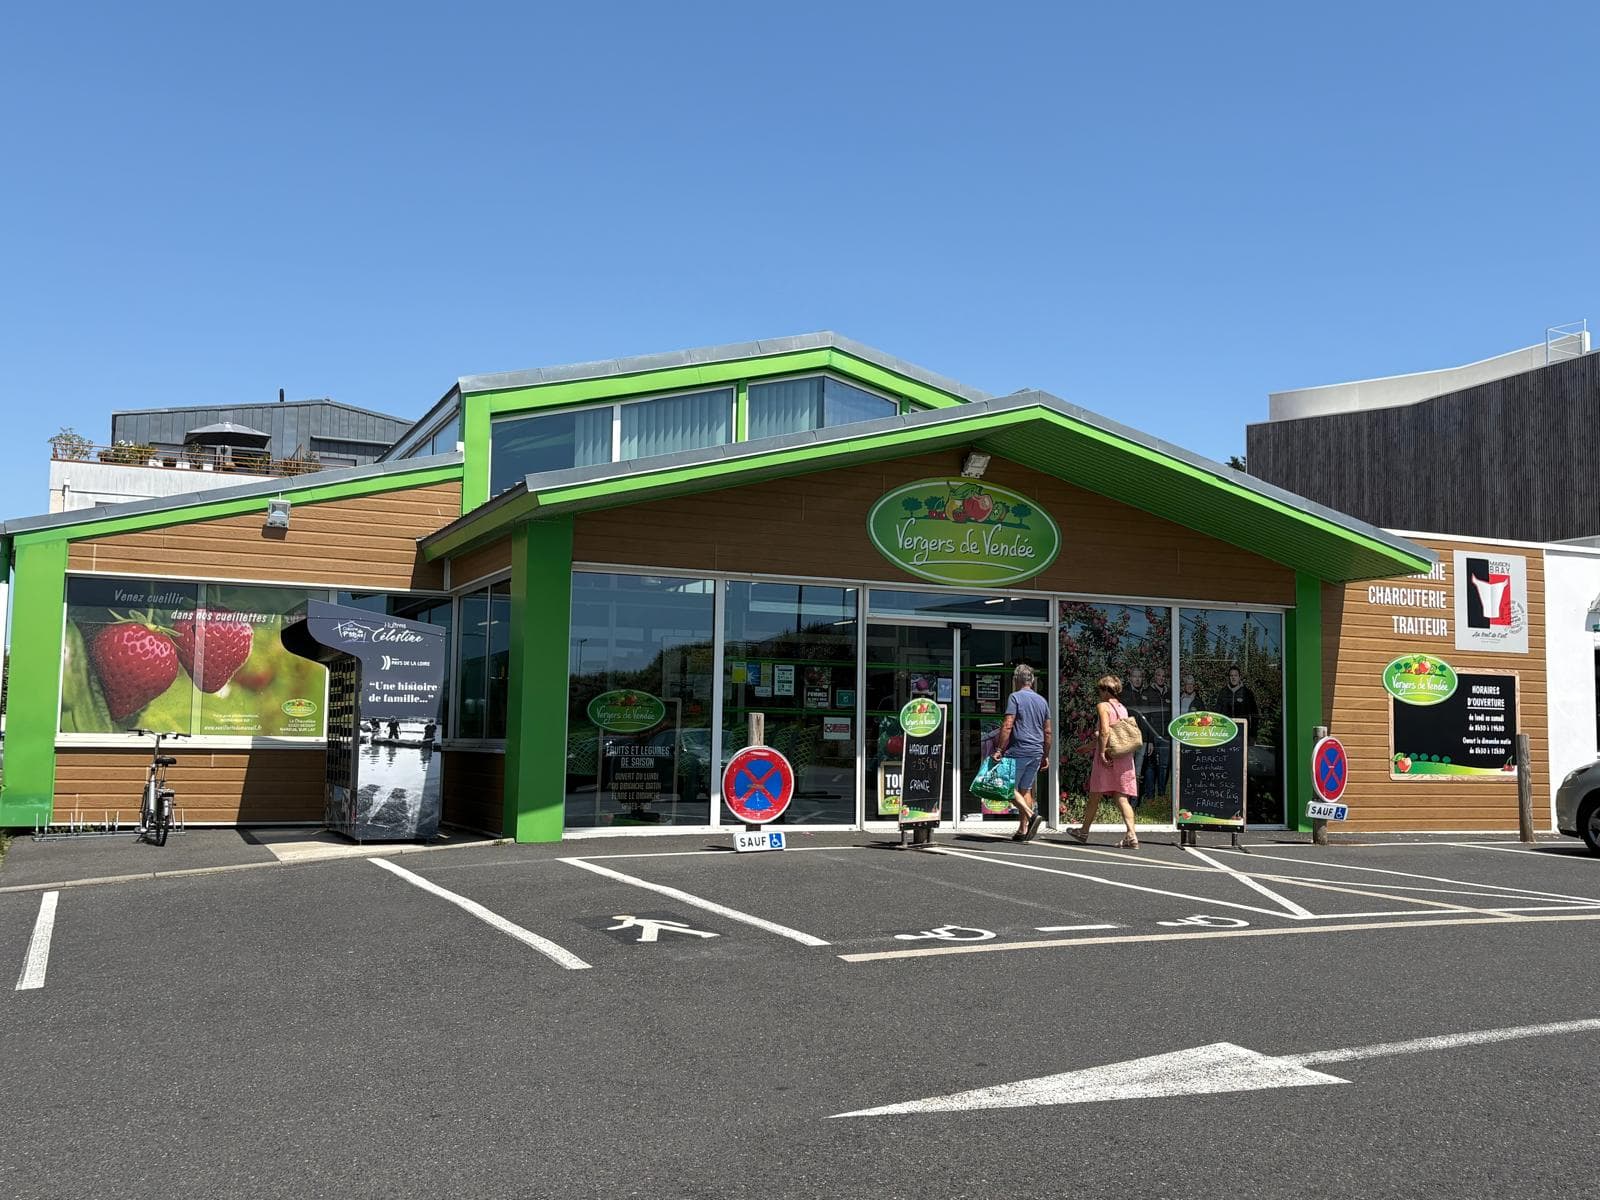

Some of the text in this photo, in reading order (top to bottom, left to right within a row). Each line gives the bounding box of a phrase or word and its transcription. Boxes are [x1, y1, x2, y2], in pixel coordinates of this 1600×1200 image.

[895, 518, 1036, 566] Vergers de Vendée
[1489, 560, 1511, 568] MAISON
[1489, 566, 1511, 574] BRAY
[114, 589, 184, 605] Venez cueillir
[1367, 585, 1447, 609] CHARCUTERIE
[170, 609, 193, 621] dans
[196, 611, 212, 621] nos
[215, 611, 267, 623] cueillettes
[1391, 615, 1448, 637] TRAITEUR
[397, 682, 438, 691] histoire
[1391, 672, 1449, 695] Vergers de Vendée
[1471, 685, 1500, 695] HORAIRES
[368, 693, 382, 702] de
[1467, 697, 1505, 708] D'OUVERTURE
[596, 705, 656, 725] Vergers de Vendée
[1474, 712, 1485, 721] lundi
[1491, 713, 1505, 722] samedi
[905, 712, 919, 731] Vergers
[924, 712, 936, 725] Vendée
[1176, 725, 1229, 741] Vergers de Vendée
[1462, 737, 1476, 745] Ouvert
[1477, 737, 1481, 745] le
[1481, 737, 1500, 745] dimanche
[606, 746, 630, 755] FRUITS
[631, 746, 640, 755] ET
[909, 743, 929, 755] HARICOT
[620, 758, 655, 768] DE SAISON
[909, 779, 930, 793] FRANCE
[1195, 797, 1225, 809] FRANCE
[1311, 806, 1334, 817] SAUF
[739, 836, 767, 848] SAUF
